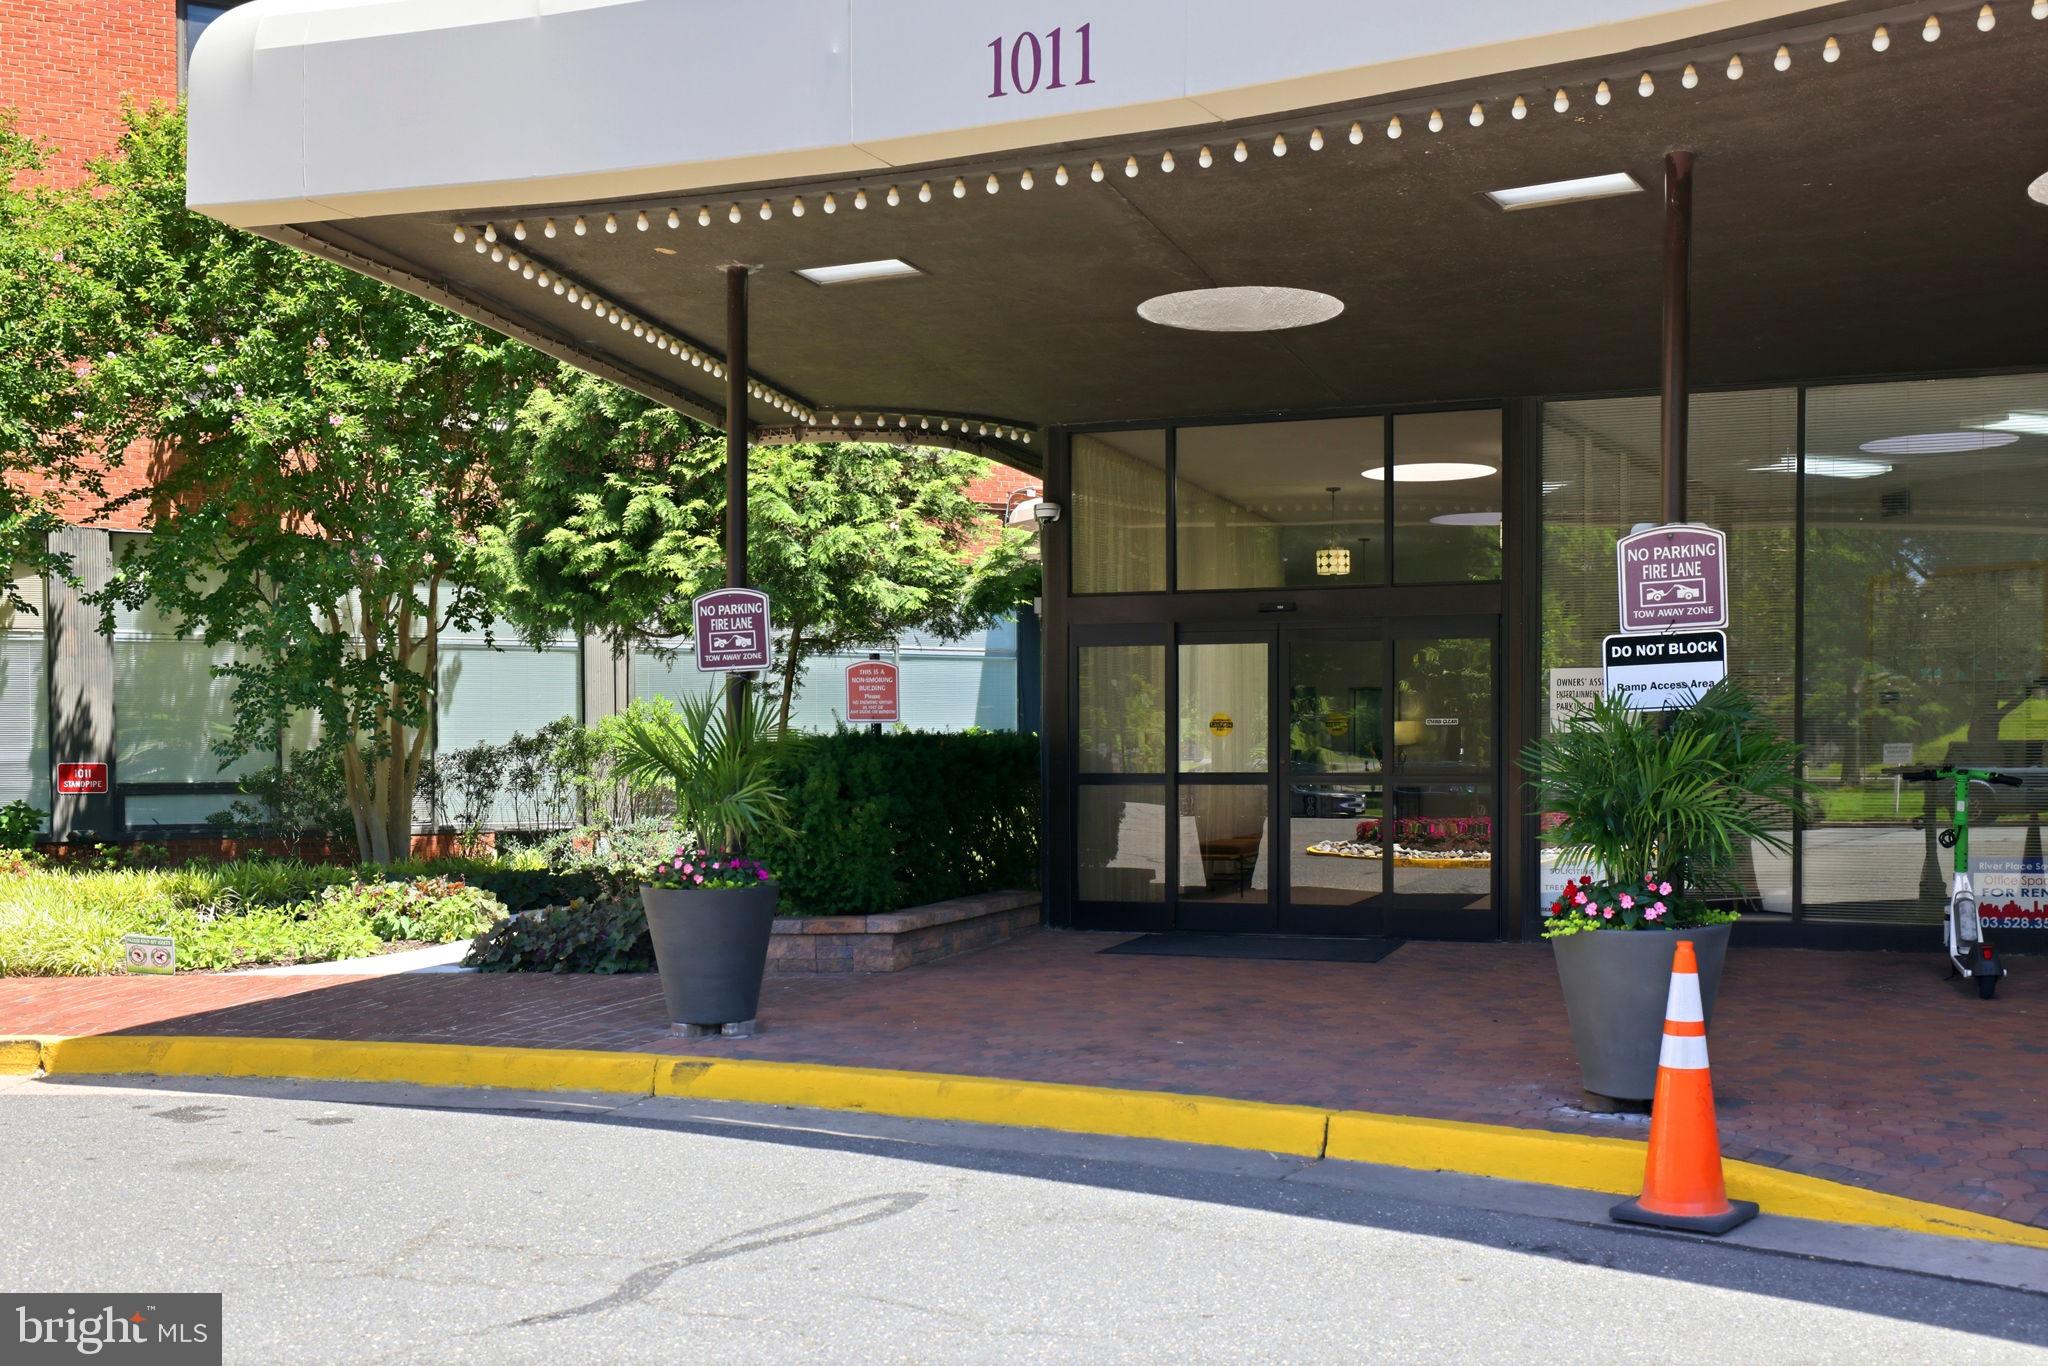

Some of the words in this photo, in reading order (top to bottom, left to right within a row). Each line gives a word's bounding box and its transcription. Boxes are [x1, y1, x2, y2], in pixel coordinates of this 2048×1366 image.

[987, 22, 1096, 99] 1011
[1627, 548, 1649, 562] NO
[1653, 543, 1716, 560] PARKING
[1642, 563, 1668, 580] FIRE
[1671, 561, 1702, 578] LANE
[700, 605, 716, 617] NO
[718, 602, 763, 616] PARKING
[1633, 610, 1655, 619] TOW
[1657, 608, 1684, 617] AWAY
[1686, 605, 1714, 615] ZONE
[710, 618, 729, 631] FIRE
[730, 616, 753, 630] LANE
[1611, 645, 1632, 658] DO
[1636, 643, 1665, 657] NOT
[1668, 640, 1718, 655] BLOCK
[704, 654, 720, 662] TOW
[722, 653, 741, 661] AWAY
[742, 652, 763, 660] ZONE
[1617, 683, 1647, 693] Ramp
[1650, 681, 1688, 690] Access
[1690, 679, 1715, 688] Area
[74, 768, 92, 779] 1011
[63, 780, 103, 788] STANDPIPE
[1979, 862, 2004, 870] River
[2005, 862, 2033, 870] Place
[2035, 862, 2048, 870] So
[1984, 875, 2018, 886] Office
[2021, 875, 2048, 887] Spac
[1982, 887, 2015, 897] FOR
[2021, 888, 2048, 897] REN
